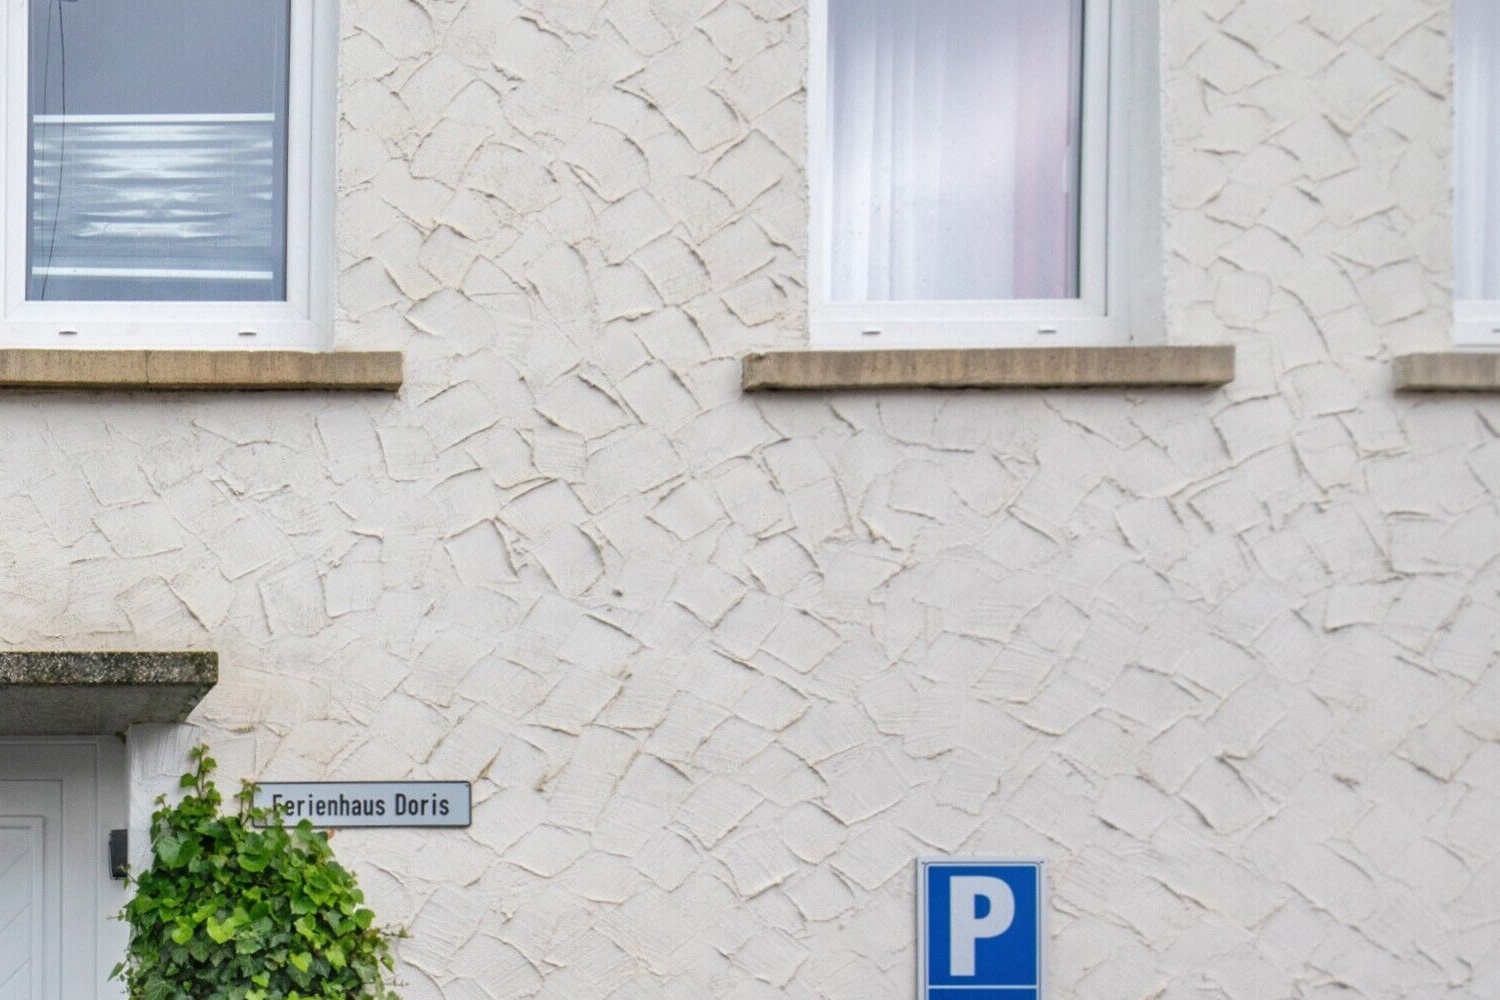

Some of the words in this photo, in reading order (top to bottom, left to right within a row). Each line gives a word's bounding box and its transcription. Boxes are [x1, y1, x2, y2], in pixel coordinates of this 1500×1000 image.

[272, 793, 385, 816] Ferienhaus
[395, 793, 450, 816] Doris
[950, 875, 1015, 976] P
